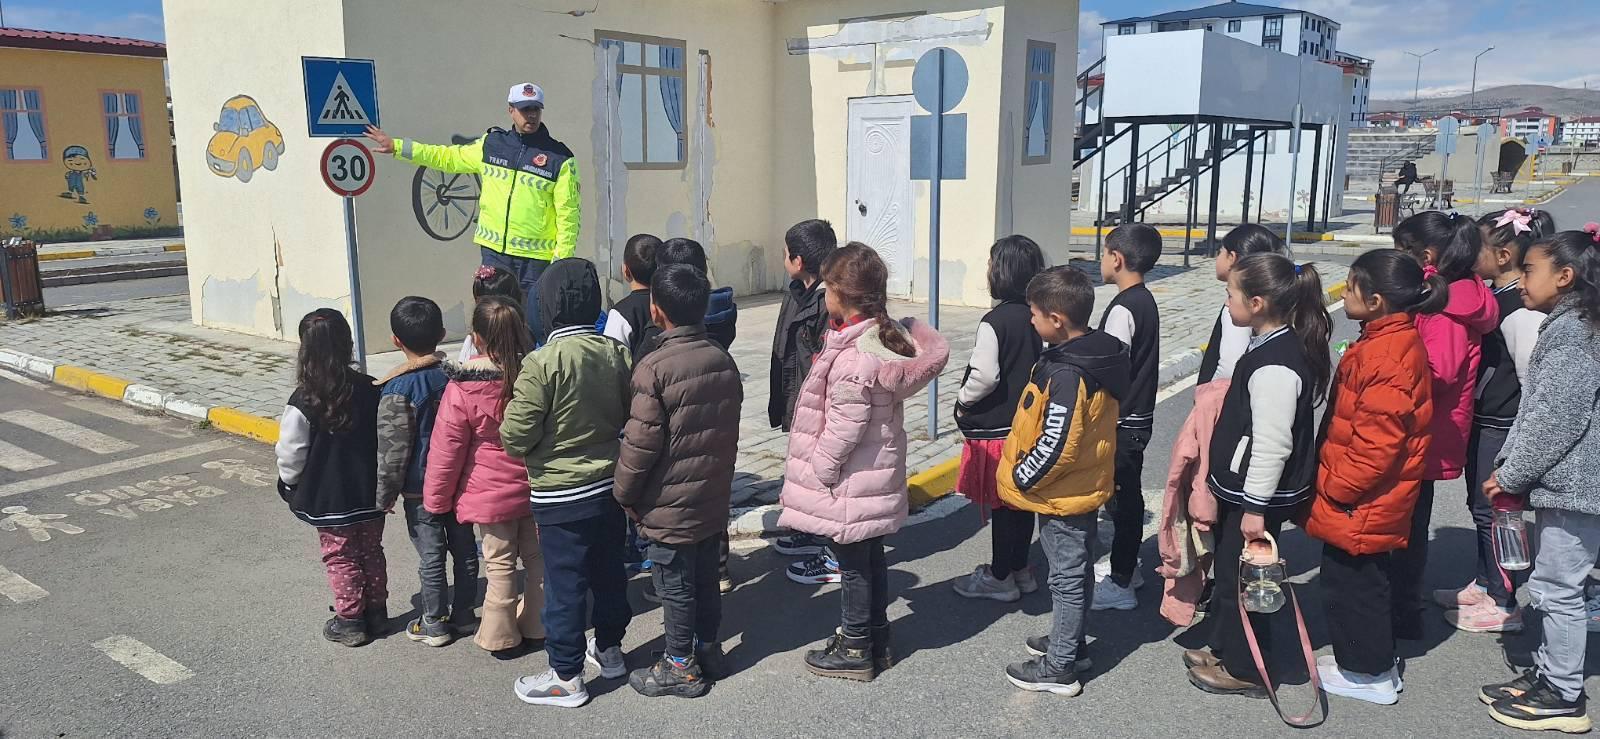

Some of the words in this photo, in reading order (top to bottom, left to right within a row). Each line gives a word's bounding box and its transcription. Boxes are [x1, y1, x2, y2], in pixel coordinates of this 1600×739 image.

[332, 155, 366, 181] 30
[1016, 402, 1068, 484] ADVENTURE
[65, 475, 198, 506] önce
[96, 485, 228, 520] yaya
